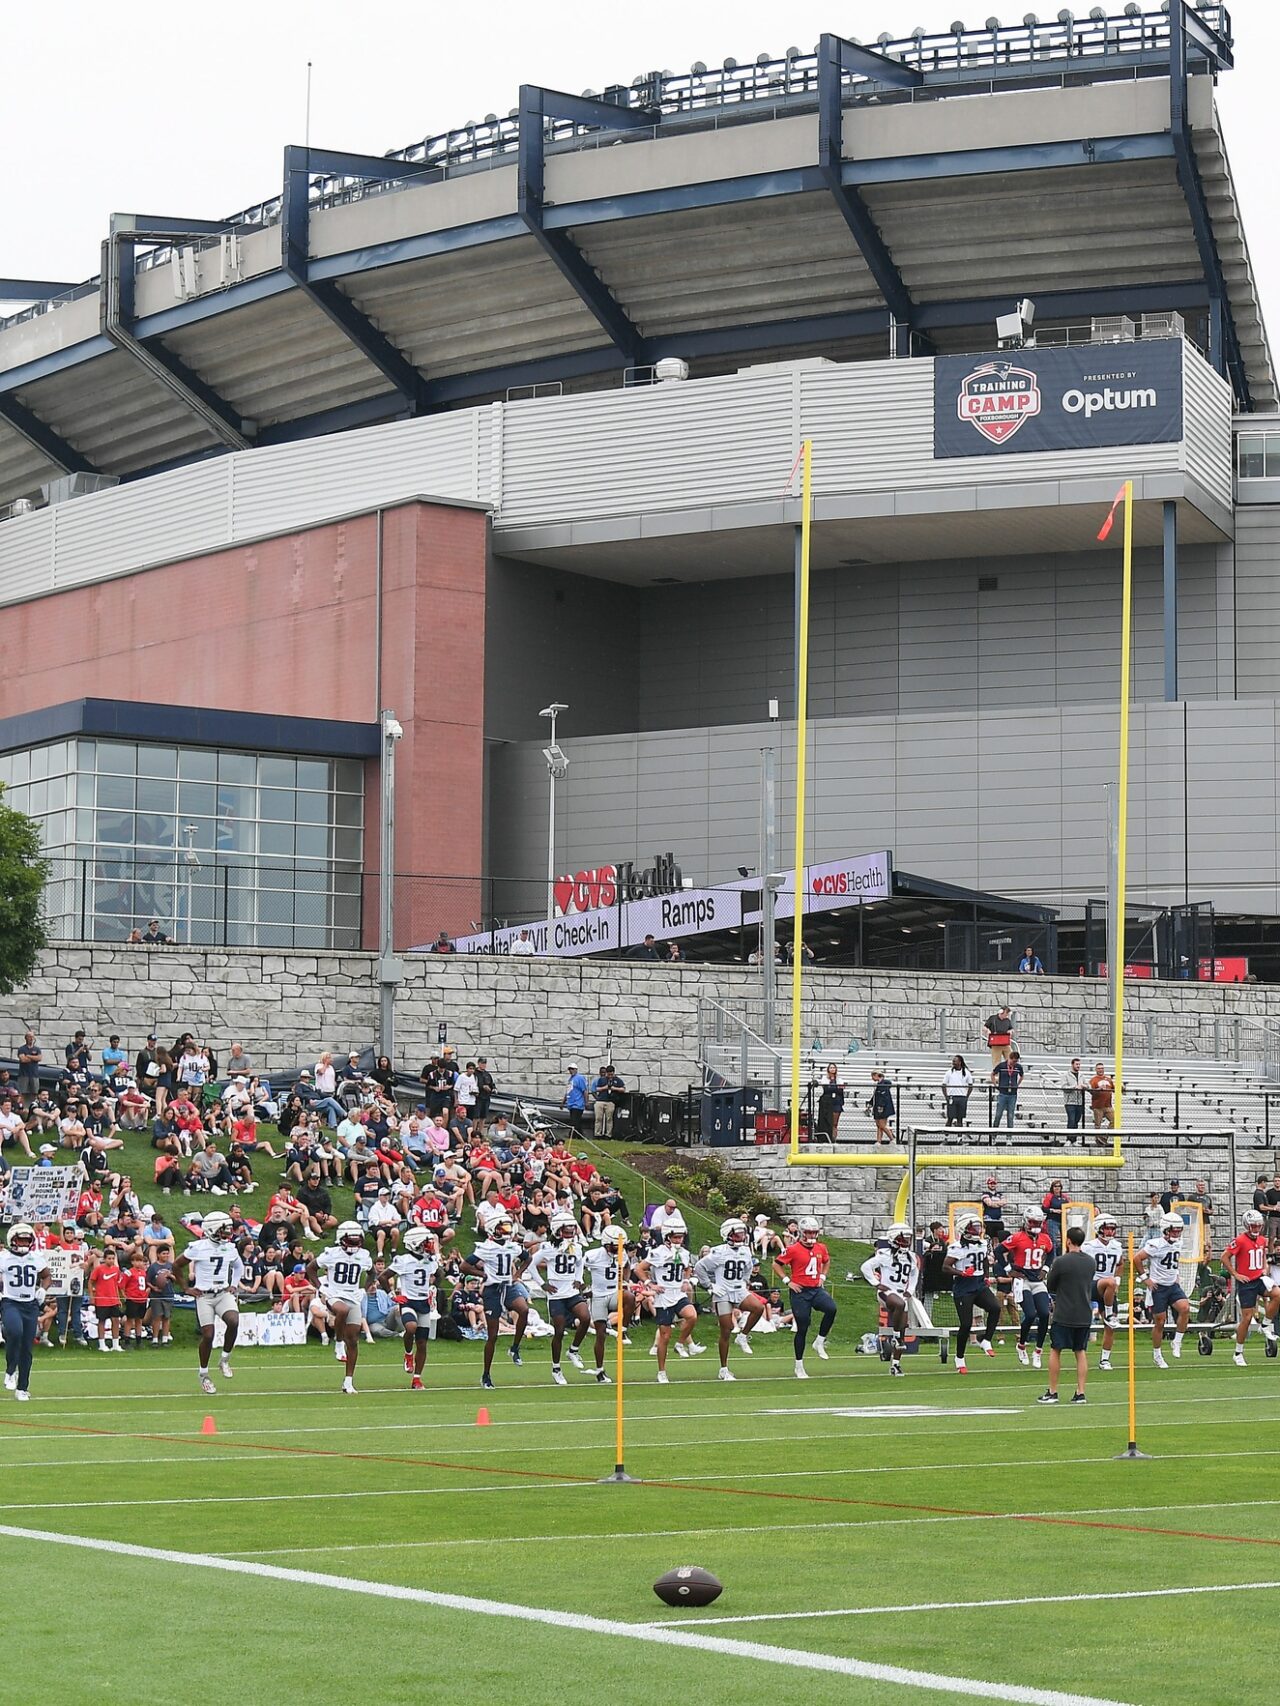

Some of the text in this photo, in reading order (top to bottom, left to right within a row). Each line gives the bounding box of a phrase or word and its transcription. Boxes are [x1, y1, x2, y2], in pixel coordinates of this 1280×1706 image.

[972, 380, 1026, 393] TRAINING
[1083, 371, 1137, 382] PRESENTED BY
[968, 394, 1031, 414] CAMP
[1062, 388, 1156, 418] Optum
[661, 897, 715, 930] Ramps
[555, 916, 609, 949] Check-In
[422, 1208, 439, 1222] 80
[210, 1256, 224, 1276] 7
[496, 1253, 512, 1276] 11
[554, 1254, 576, 1275] 82
[805, 1256, 818, 1279] 4
[966, 1252, 984, 1272] 38
[1023, 1248, 1044, 1270] 19
[1095, 1253, 1116, 1273] 87
[1161, 1251, 1179, 1270] 49
[1248, 1249, 1263, 1270] 10
[8, 1264, 37, 1287] 36
[334, 1261, 361, 1285] 80
[413, 1268, 427, 1287] 3
[662, 1262, 686, 1282] 30
[889, 1262, 911, 1285] 39
[138, 1275, 146, 1291] 9
[267, 1312, 295, 1321] DRAKE
